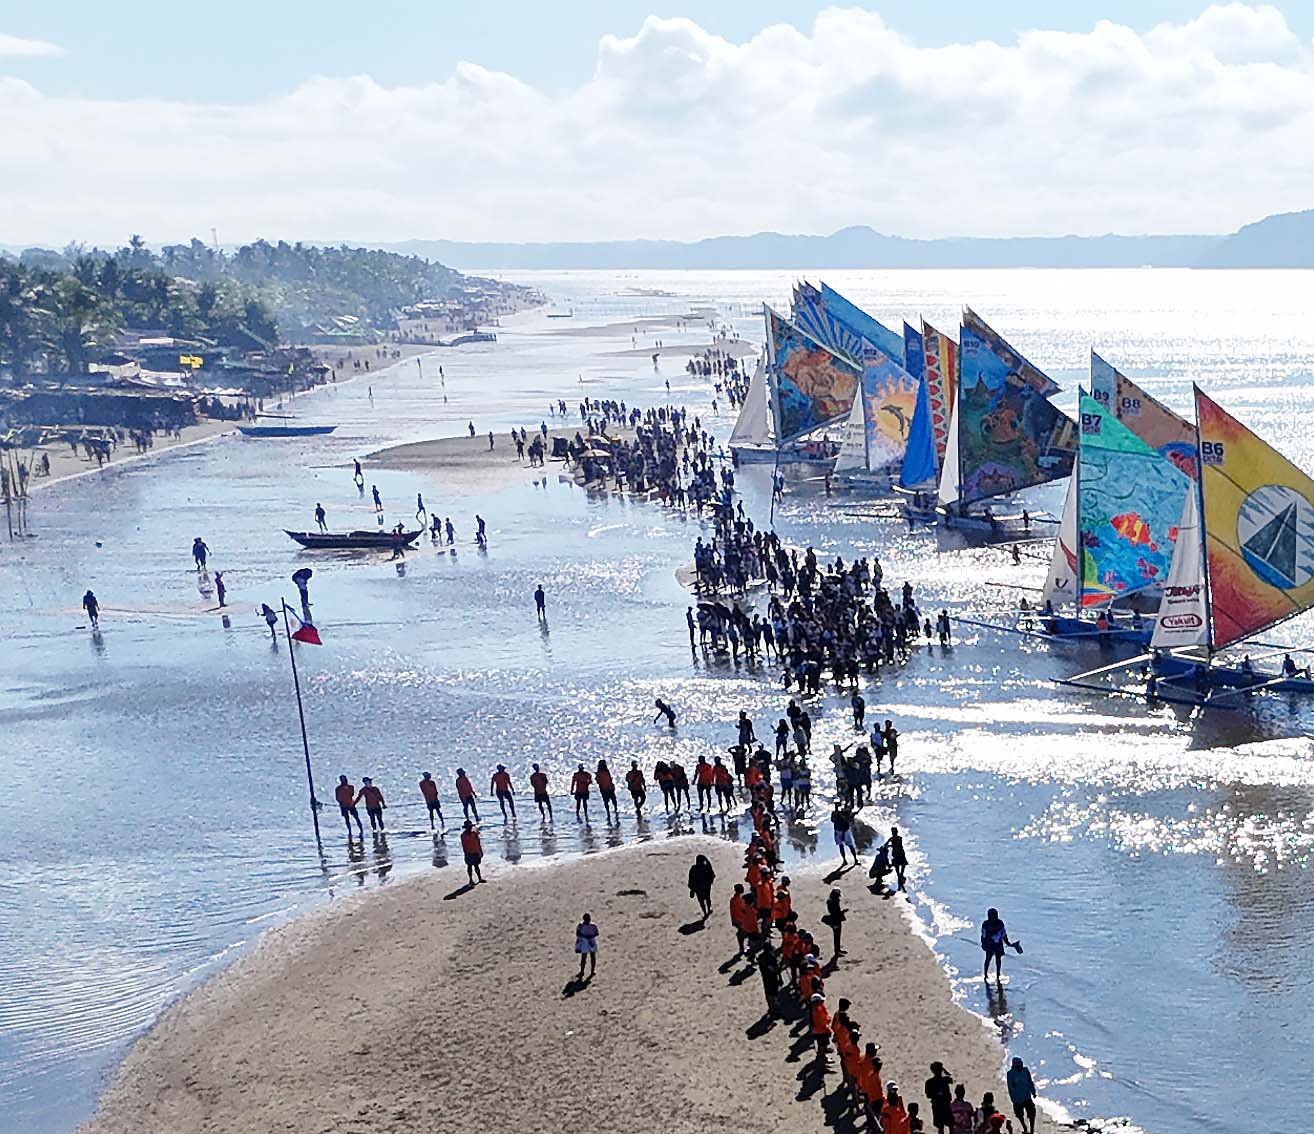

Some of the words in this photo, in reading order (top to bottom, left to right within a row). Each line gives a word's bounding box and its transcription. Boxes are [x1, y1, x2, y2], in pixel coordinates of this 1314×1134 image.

[1093, 389, 1110, 402] B9
[1122, 397, 1141, 409] B8
[1081, 413, 1102, 426] B7
[1202, 441, 1224, 457] B6
